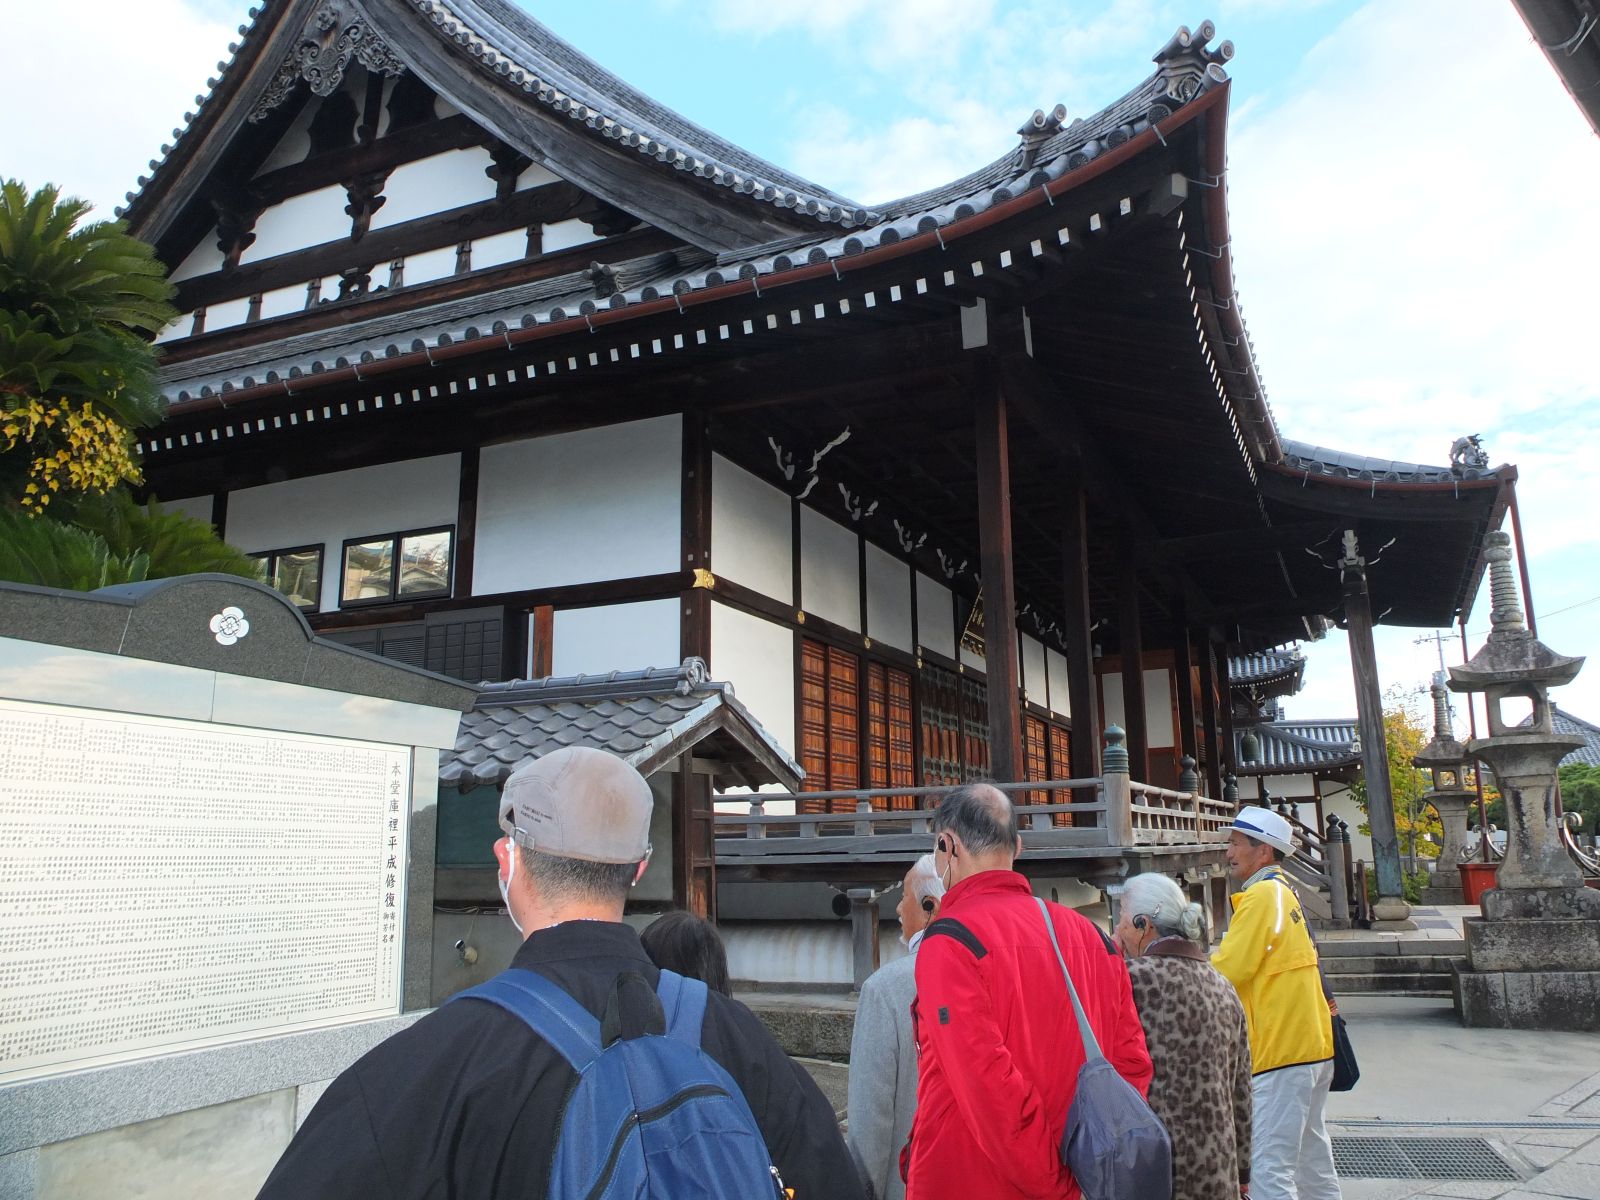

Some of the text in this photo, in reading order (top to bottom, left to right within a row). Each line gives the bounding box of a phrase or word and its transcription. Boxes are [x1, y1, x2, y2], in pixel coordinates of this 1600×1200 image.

[384, 761, 402, 908] 本堂庫裡平成修復
